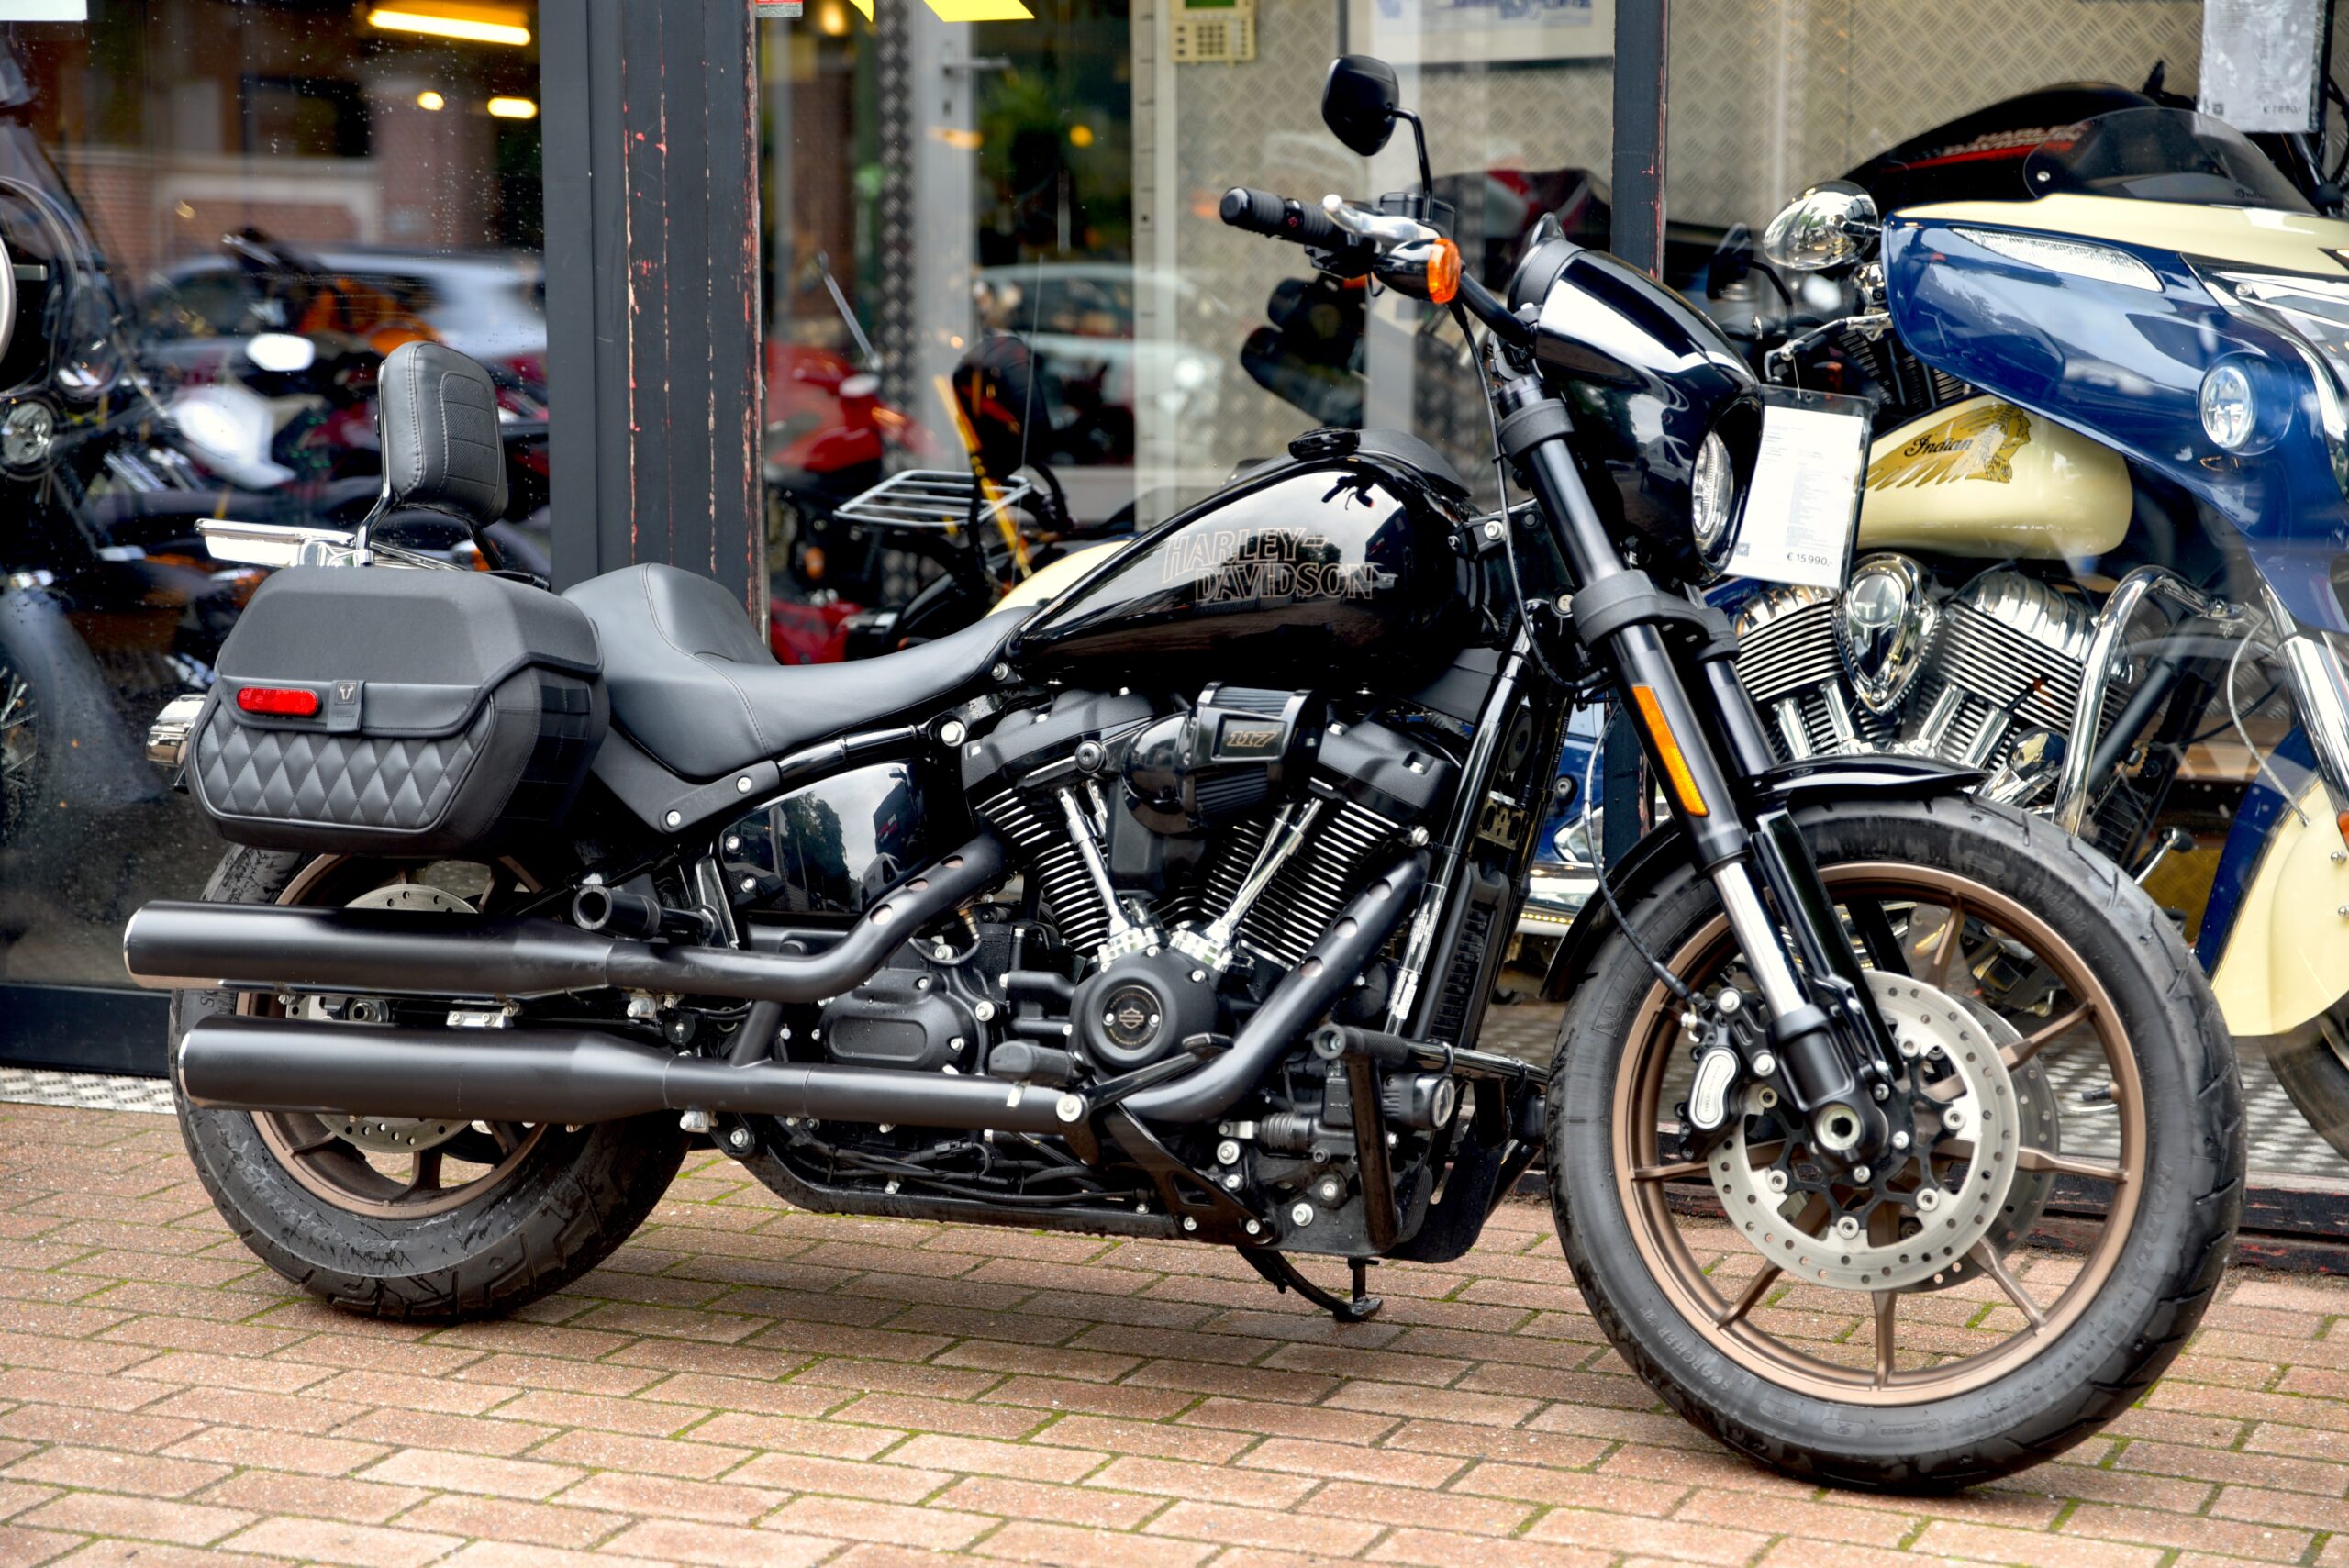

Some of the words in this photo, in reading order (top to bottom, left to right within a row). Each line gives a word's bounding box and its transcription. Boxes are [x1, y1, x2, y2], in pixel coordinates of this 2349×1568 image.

[1904, 434, 1974, 457] Indian
[1194, 562, 1375, 603] DAVIDSON
[1227, 730, 1277, 748] 117
